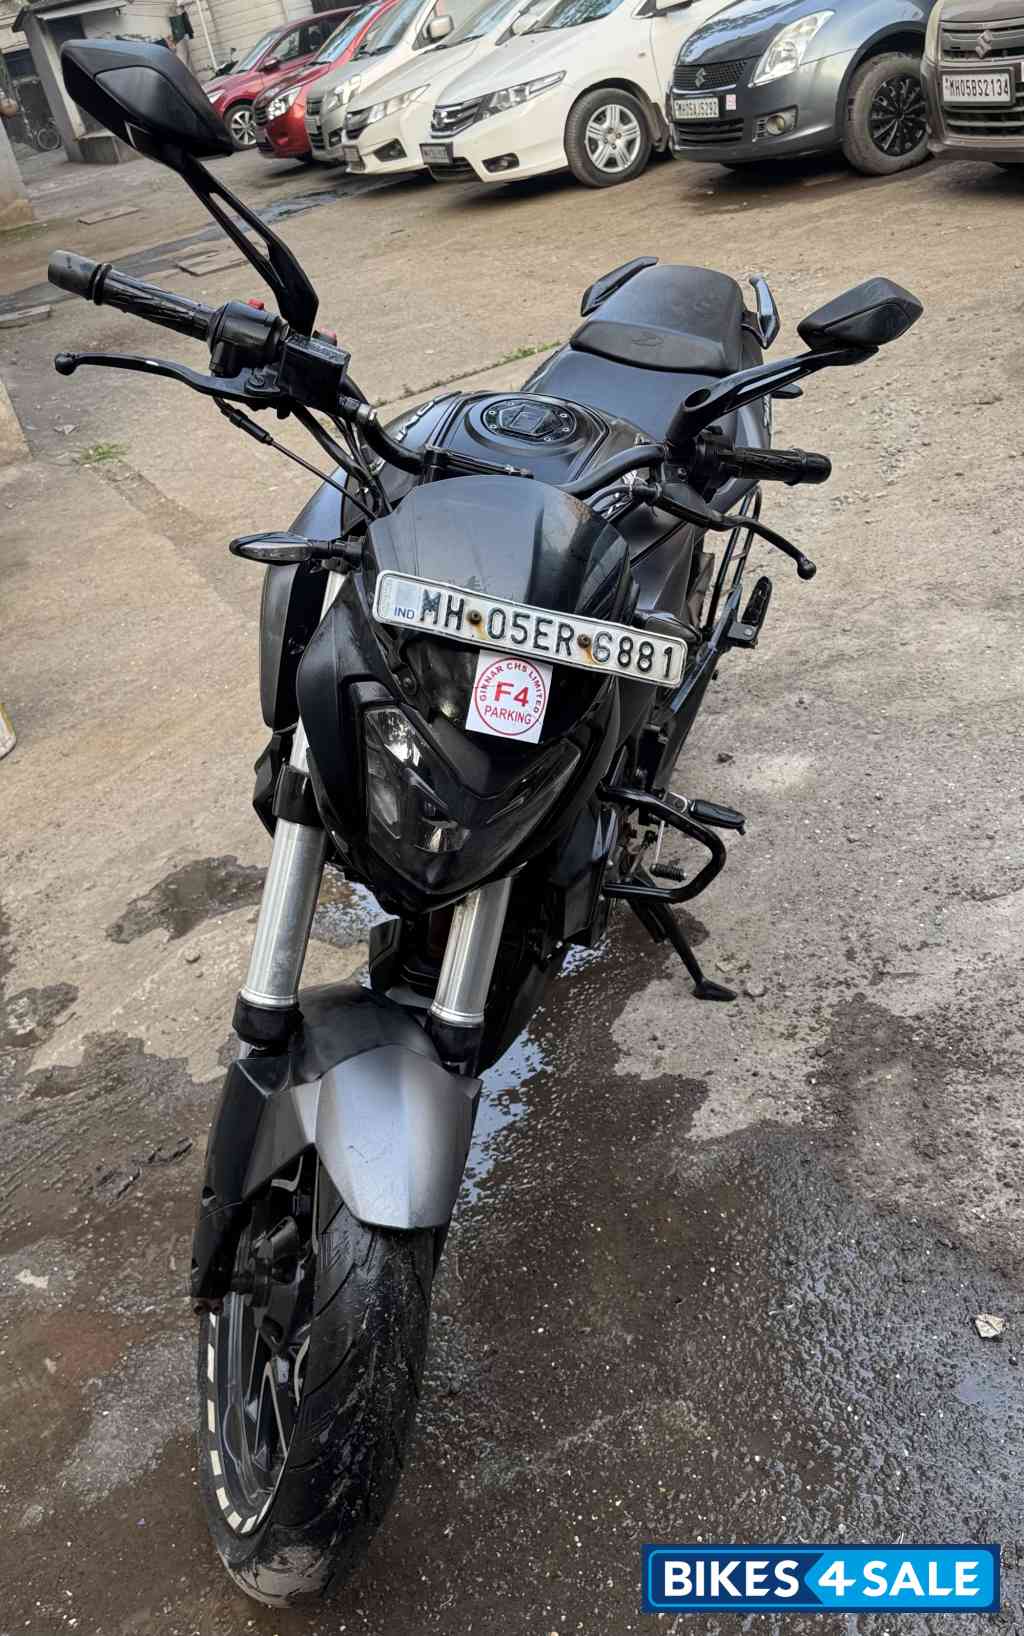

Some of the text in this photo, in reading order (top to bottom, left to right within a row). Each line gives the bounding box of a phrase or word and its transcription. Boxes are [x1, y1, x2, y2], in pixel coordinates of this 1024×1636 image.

[948, 79, 1009, 97] MH05BS2134
[393, 607, 415, 620] IND
[420, 589, 674, 678] MH 05ER 6881
[494, 681, 530, 707] F4
[506, 662, 528, 672] CHS
[528, 671, 543, 714] LIMITED
[484, 705, 532, 725] PARKING
